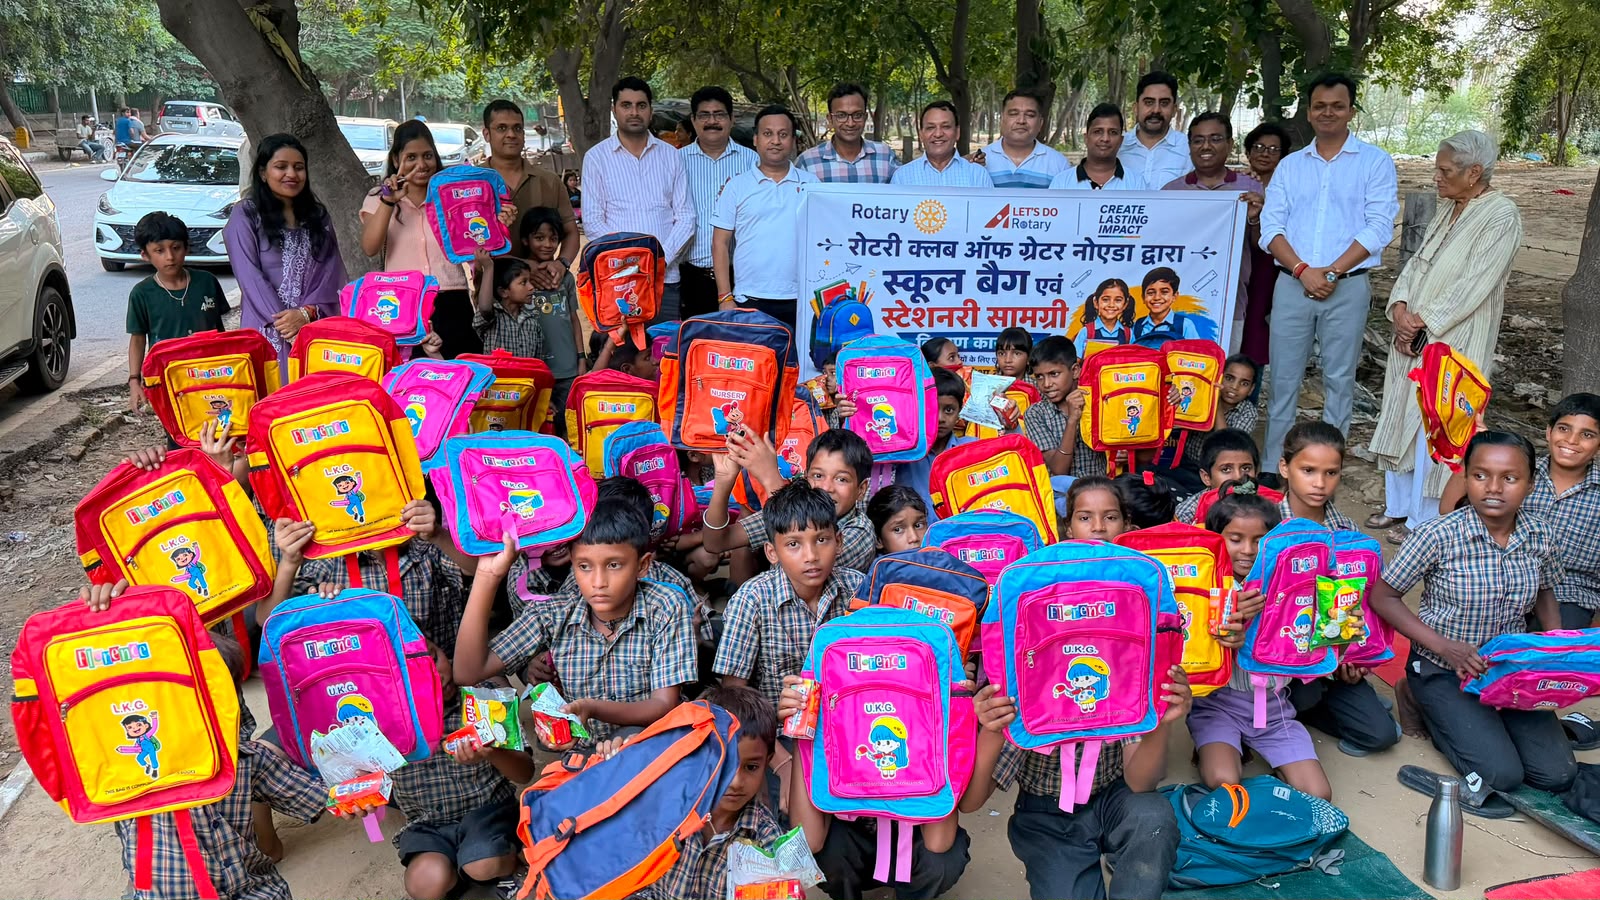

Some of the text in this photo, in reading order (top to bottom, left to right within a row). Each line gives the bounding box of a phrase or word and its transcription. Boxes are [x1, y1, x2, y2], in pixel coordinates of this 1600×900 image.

[852, 203, 909, 223] Rotary
[1013, 207, 1058, 217] LET'S DO
[1100, 204, 1146, 214] CREATE
[1012, 218, 1051, 232] Rotary
[1099, 215, 1148, 225] LASTING
[1098, 225, 1143, 235] IMPACT
[848, 231, 1185, 265] रोटरी क्लब ऑफ ग्रेटर नोएडा द्वारा
[882, 260, 1064, 303] स्कूल बैग एवं
[881, 298, 1070, 329] स्टेशनरी सामग्री
[708, 352, 755, 371] Florence
[710, 388, 747, 400] NURSERY
[324, 464, 353, 477] L.K.G.
[125, 489, 186, 526] Florence
[160, 535, 189, 552] L.K.G.
[958, 548, 1005, 563] Florence
[903, 595, 954, 624] Florence
[1047, 601, 1116, 621] Florence
[304, 635, 361, 660] Florence
[1063, 645, 1098, 655] U.K.G.
[76, 643, 150, 670] Florence
[848, 652, 907, 671] Florence
[327, 682, 358, 696] U.K.G.
[112, 700, 147, 714] L.K.G.
[864, 702, 896, 714] U.K.G.
